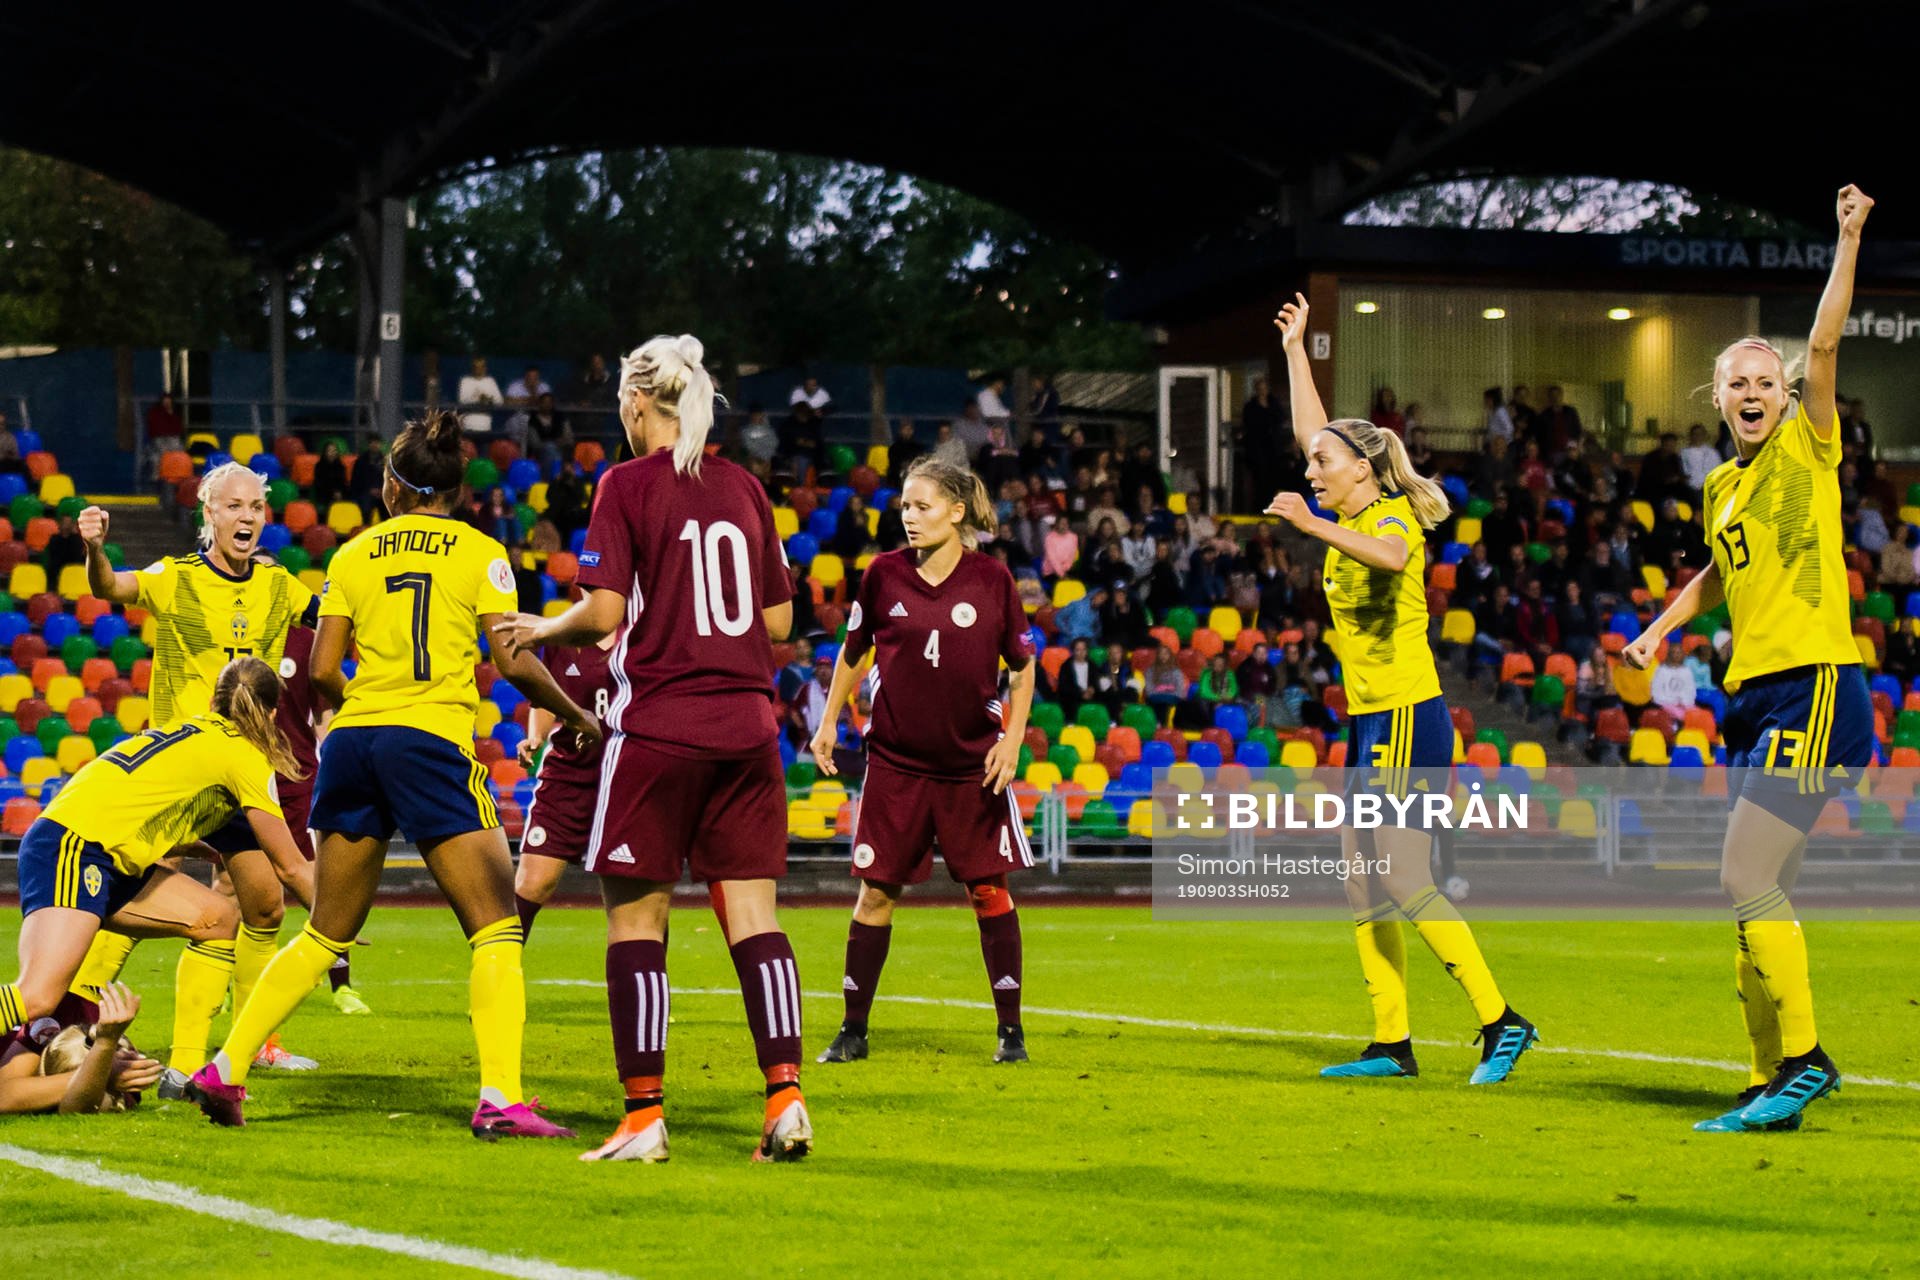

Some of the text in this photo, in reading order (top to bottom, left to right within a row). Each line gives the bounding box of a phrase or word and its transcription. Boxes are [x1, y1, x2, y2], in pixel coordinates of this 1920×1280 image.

[1620, 239, 1749, 267] SPORTA
[1842, 309, 1920, 344] afejn
[369, 530, 458, 559] JANOGY
[1716, 522, 1750, 571] 13
[678, 519, 754, 637] 10
[385, 571, 432, 681] 7
[923, 629, 941, 668] 4
[595, 687, 610, 720] 8
[1368, 744, 1390, 786] 3
[1764, 729, 1806, 779] 13
[999, 825, 1013, 863] 4
